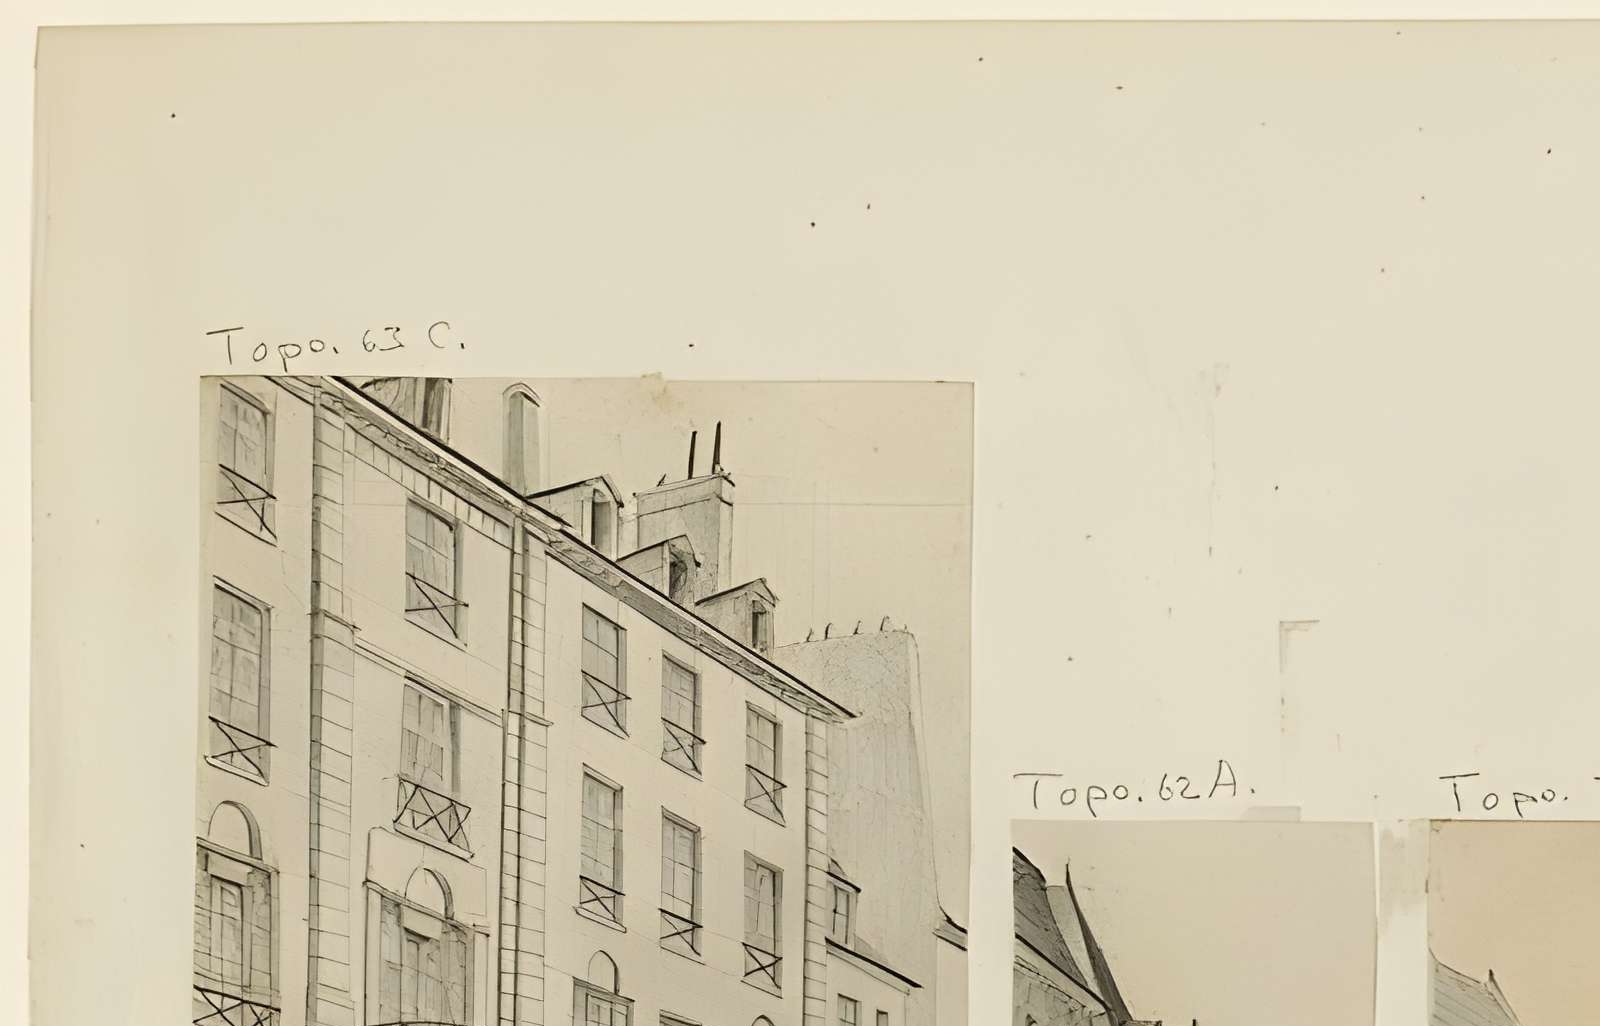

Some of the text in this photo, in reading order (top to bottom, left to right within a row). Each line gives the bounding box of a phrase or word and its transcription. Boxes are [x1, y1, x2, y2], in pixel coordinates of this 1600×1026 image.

[205, 325, 341, 374] Topo.
[361, 324, 406, 353] 63
[1012, 772, 1144, 816] Topo.
[1438, 770, 1570, 819] Topo.
